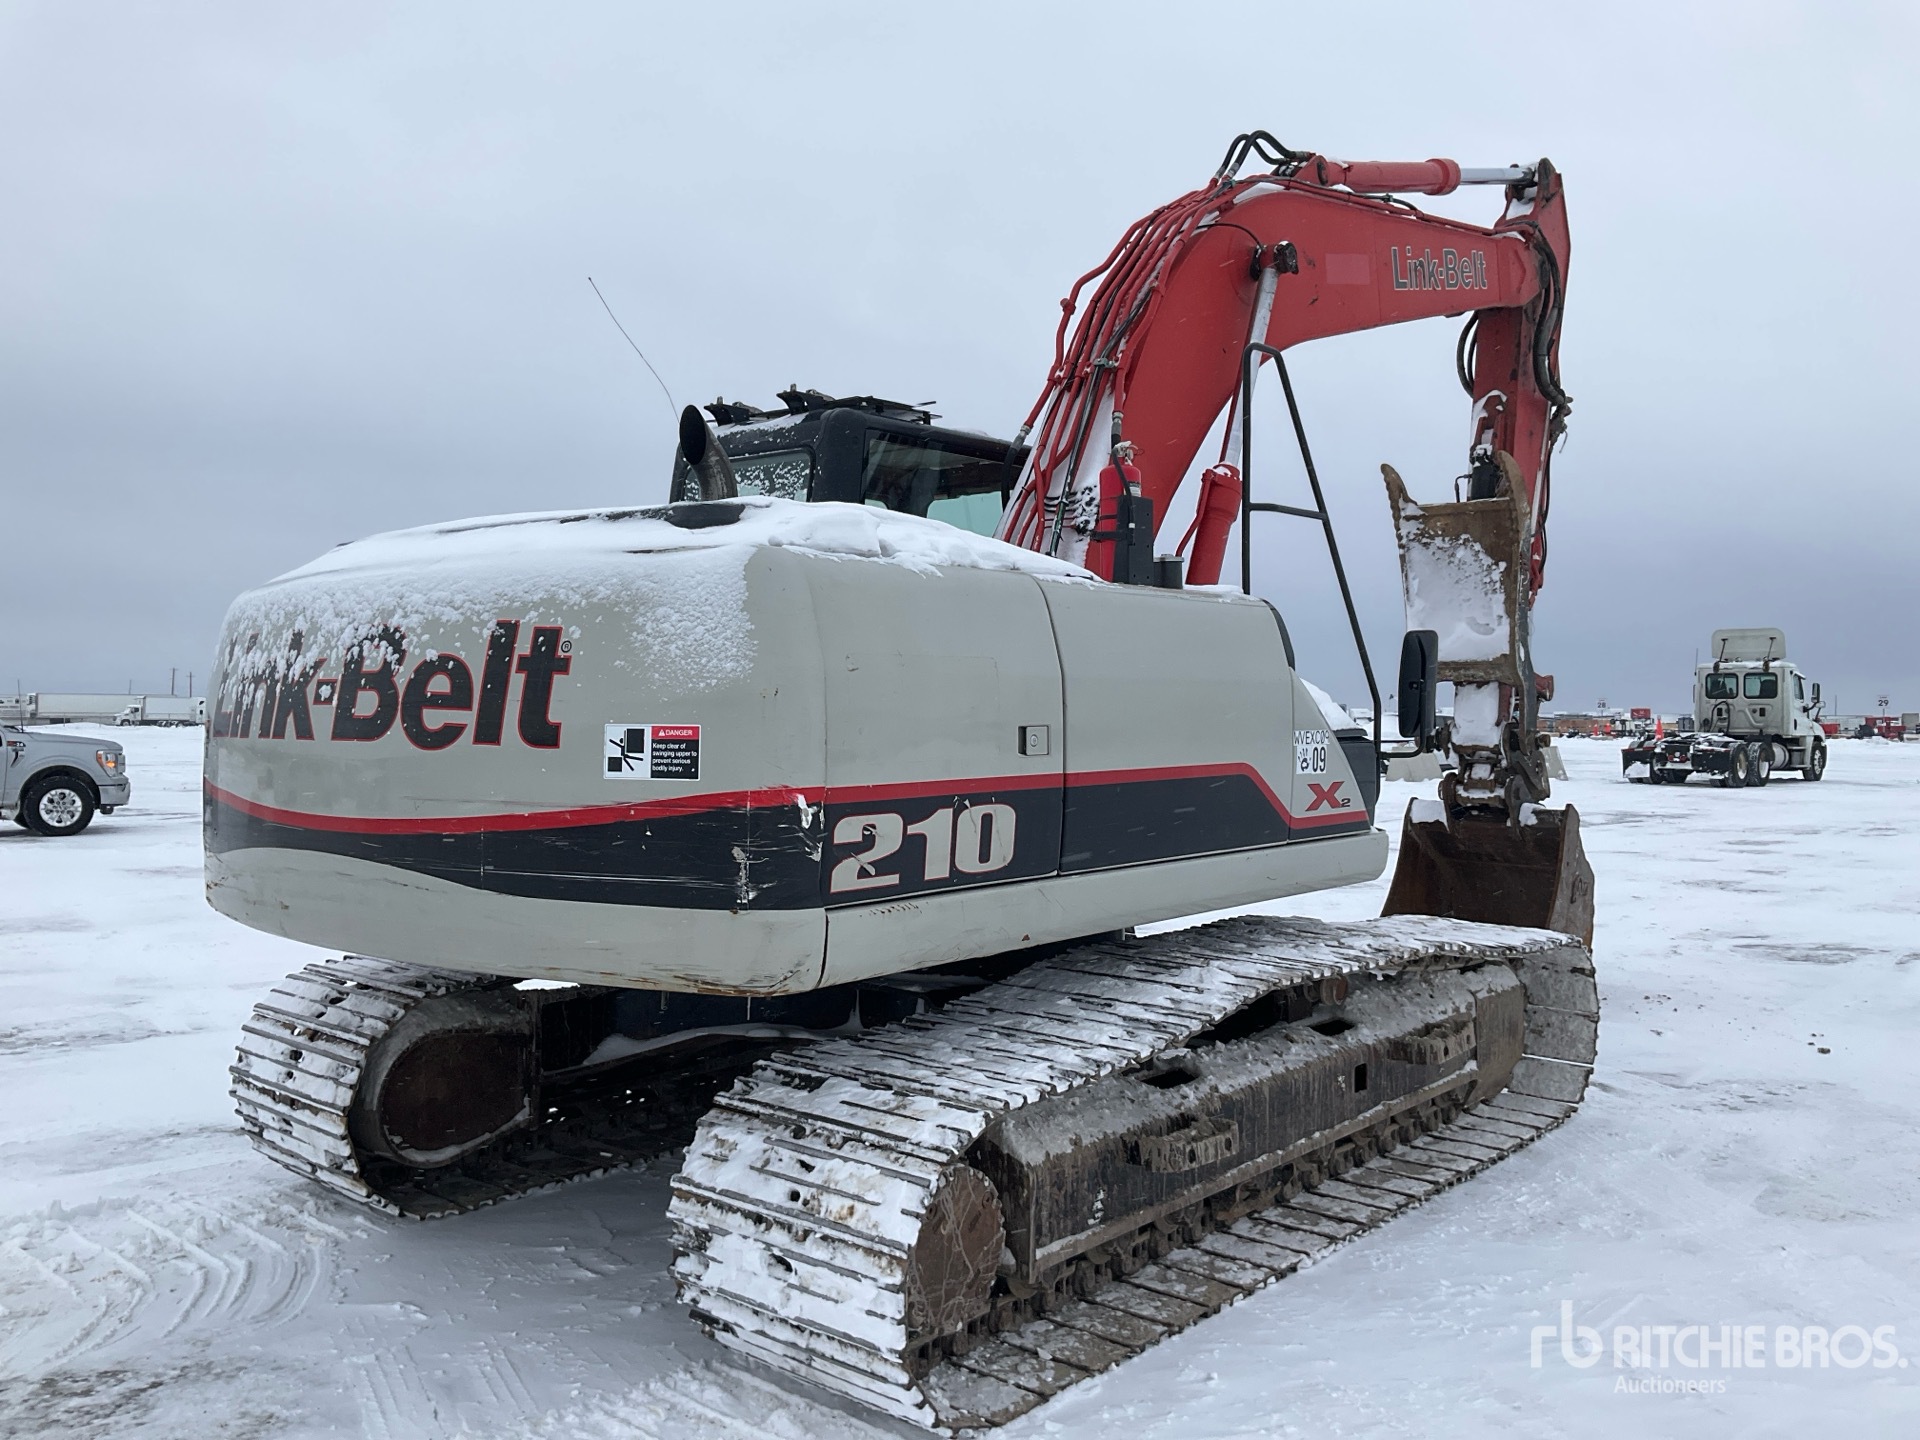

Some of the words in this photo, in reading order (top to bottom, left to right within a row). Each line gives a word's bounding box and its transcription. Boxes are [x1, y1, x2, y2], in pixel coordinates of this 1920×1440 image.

[1391, 246, 1488, 290] Link-Belt
[1878, 699, 1889, 707] 29
[652, 764, 668, 772] bodily
[1312, 746, 1327, 773] 09
[830, 803, 1016, 894] 210
